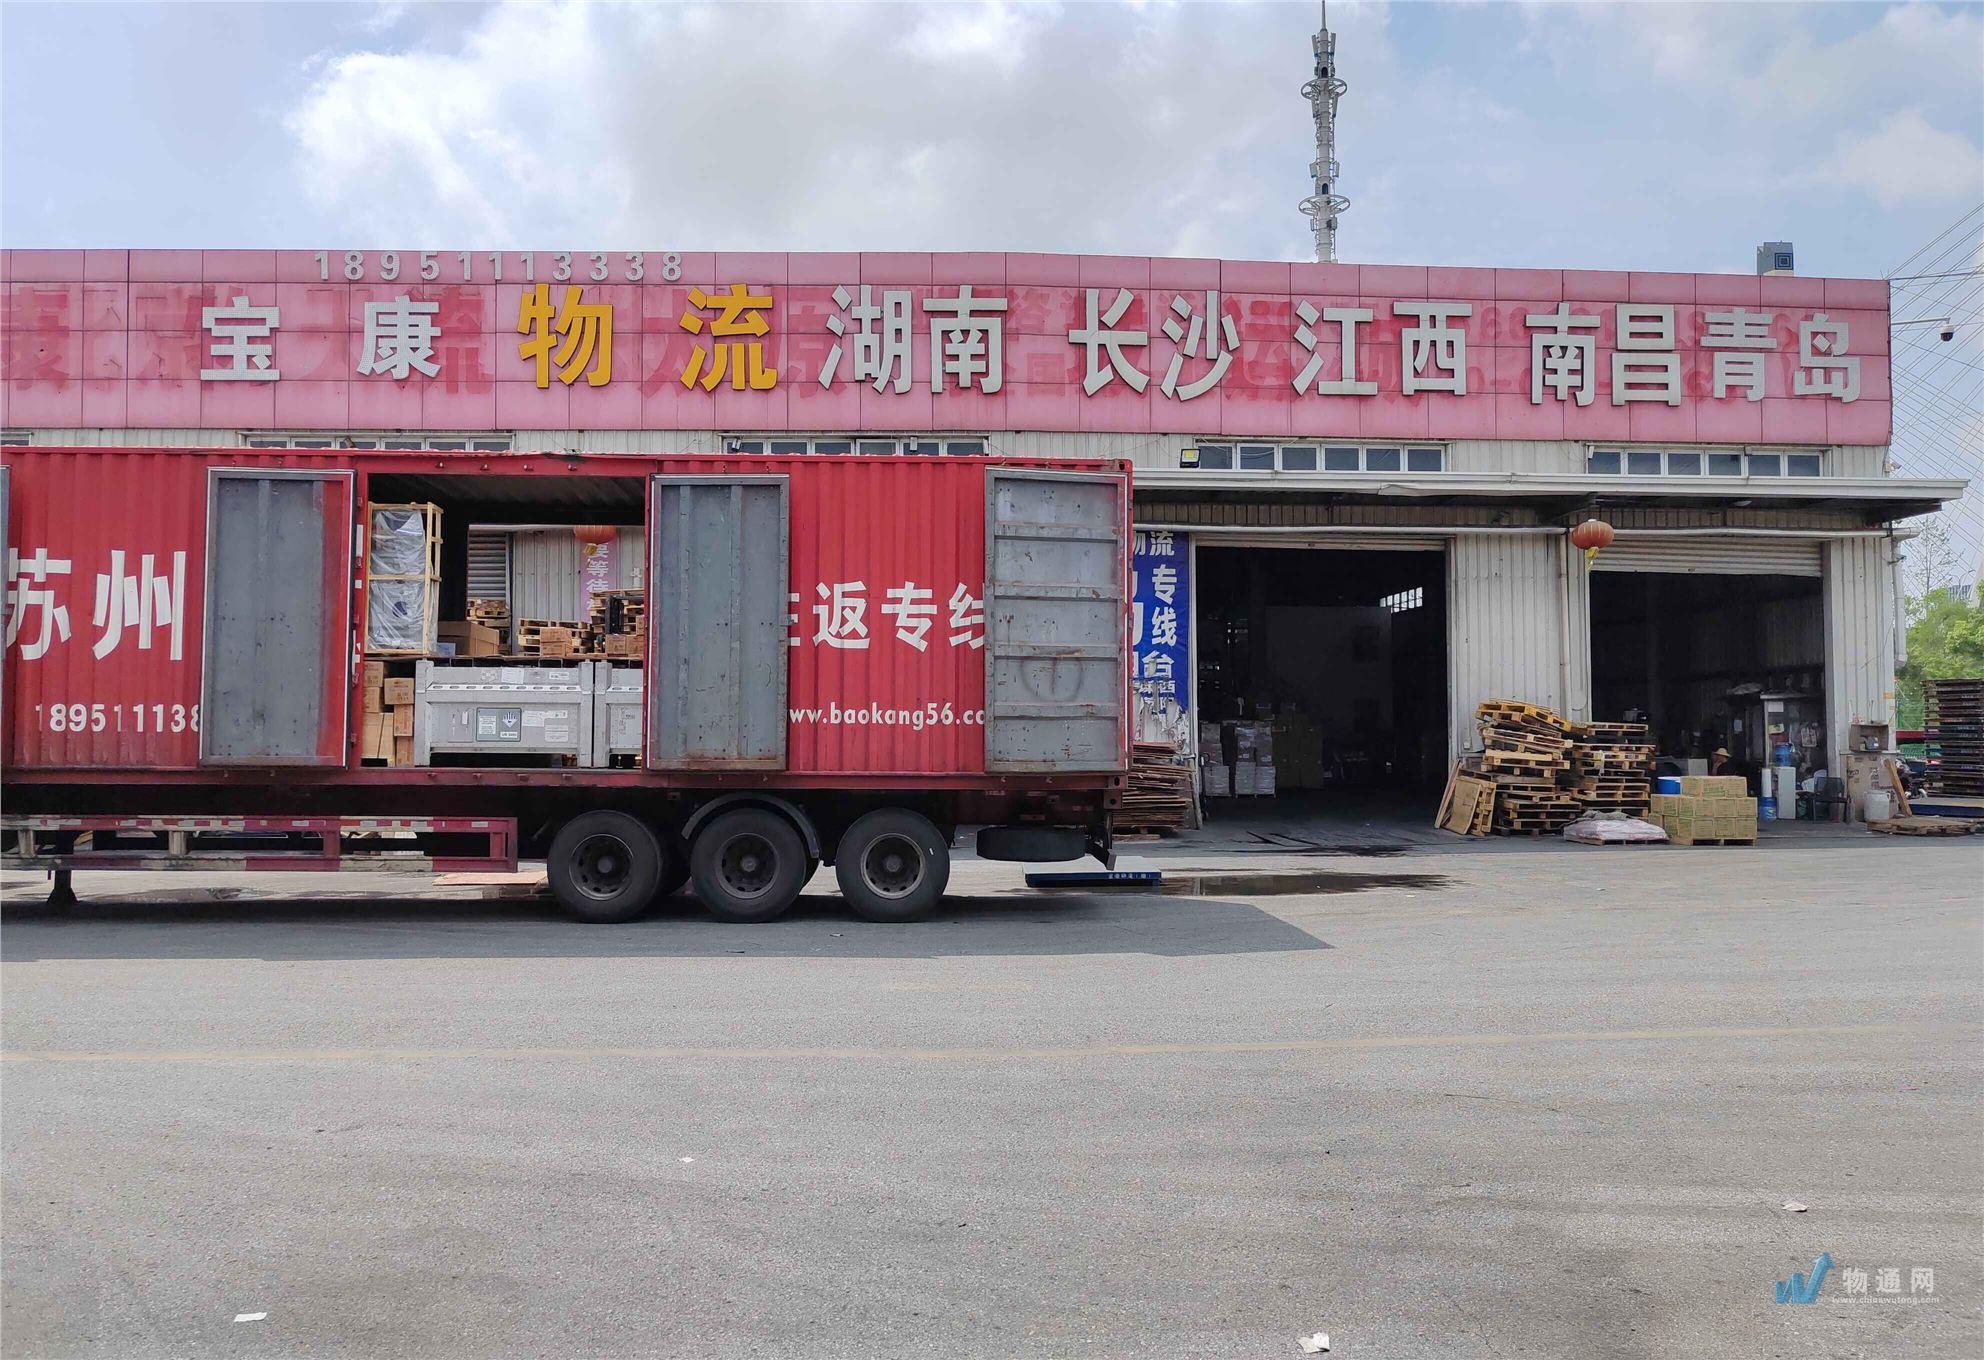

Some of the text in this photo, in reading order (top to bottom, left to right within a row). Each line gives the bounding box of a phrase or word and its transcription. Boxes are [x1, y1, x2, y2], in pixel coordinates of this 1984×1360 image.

[314, 250, 683, 281] 18951113338
[7, 547, 187, 661] 苏州
[788, 580, 984, 652] 返专线
